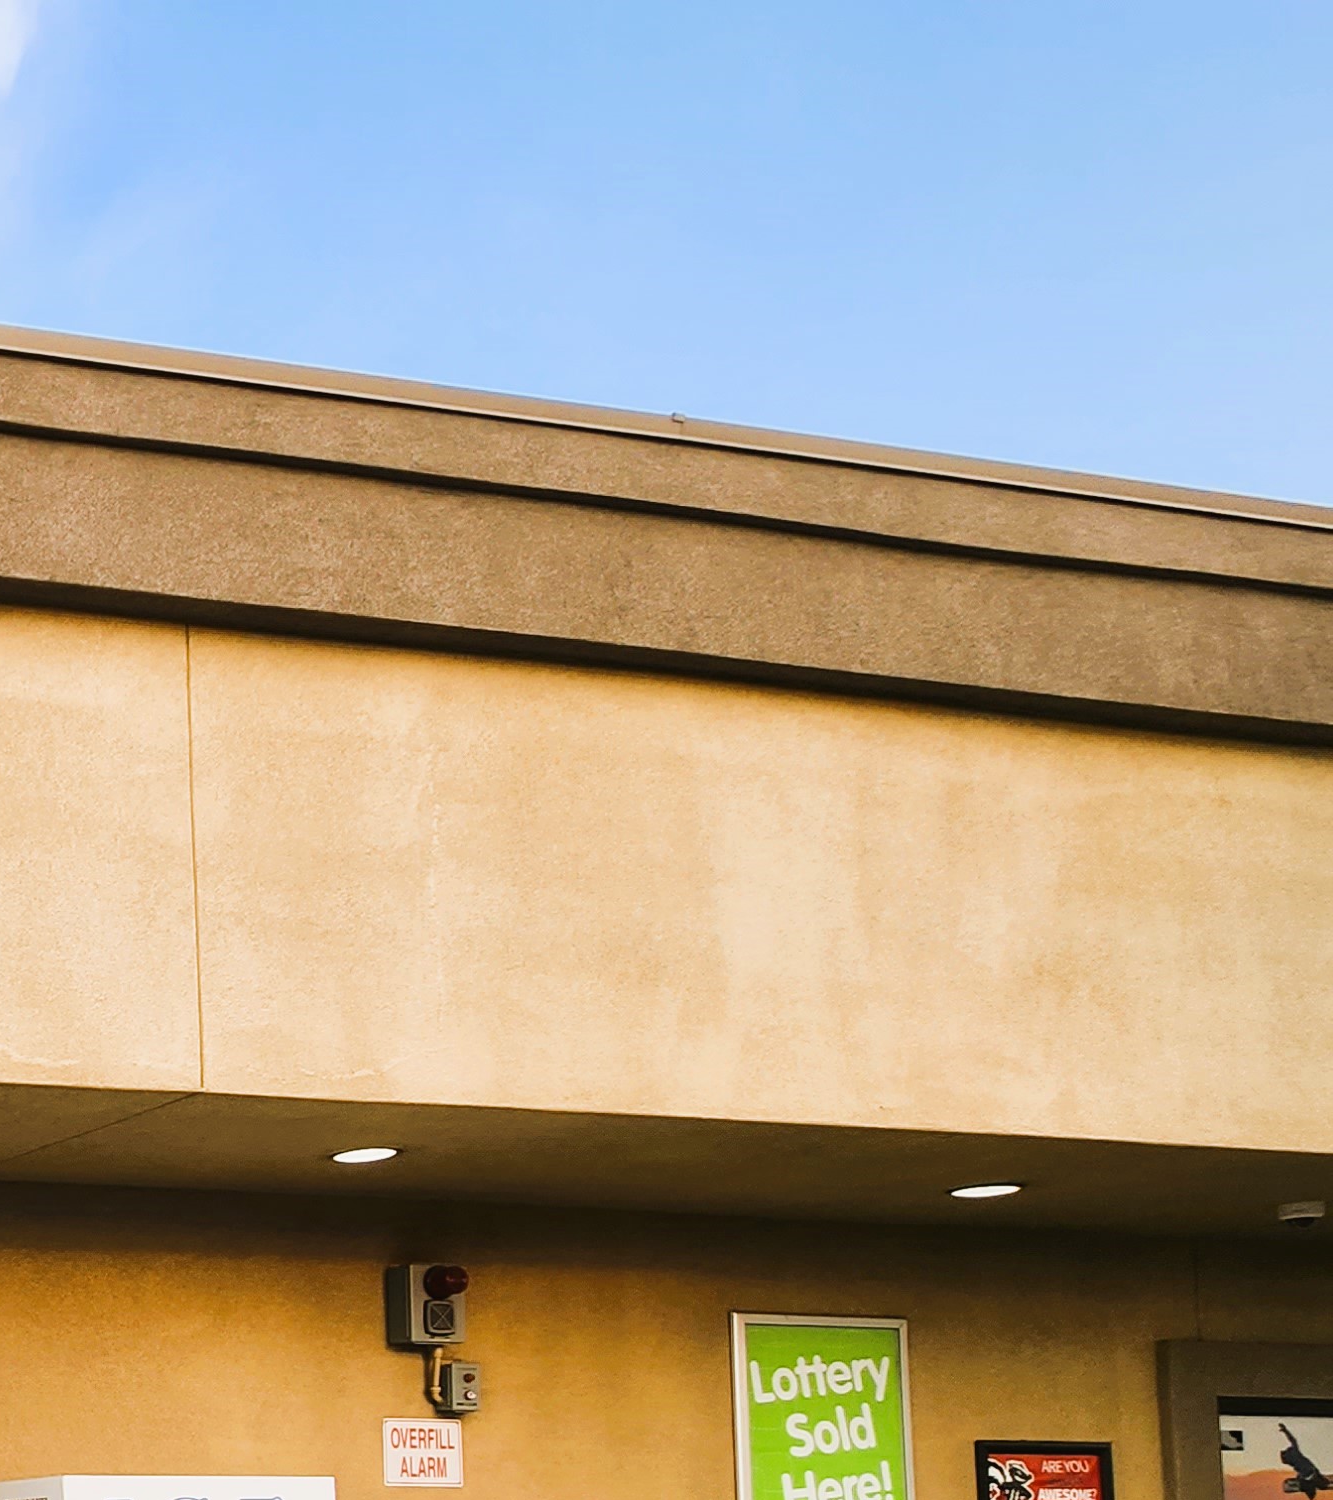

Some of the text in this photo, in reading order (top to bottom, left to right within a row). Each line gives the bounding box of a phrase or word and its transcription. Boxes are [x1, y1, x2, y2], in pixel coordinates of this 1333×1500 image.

[750, 1355, 890, 1404] Lottery
[390, 1427, 455, 1450] OVERFILL
[785, 1402, 877, 1458] Sold
[400, 1456, 448, 1479] ALARM
[1041, 1460, 1090, 1473] ARE YOU
[1037, 1488, 1098, 1500] AWESOME?
